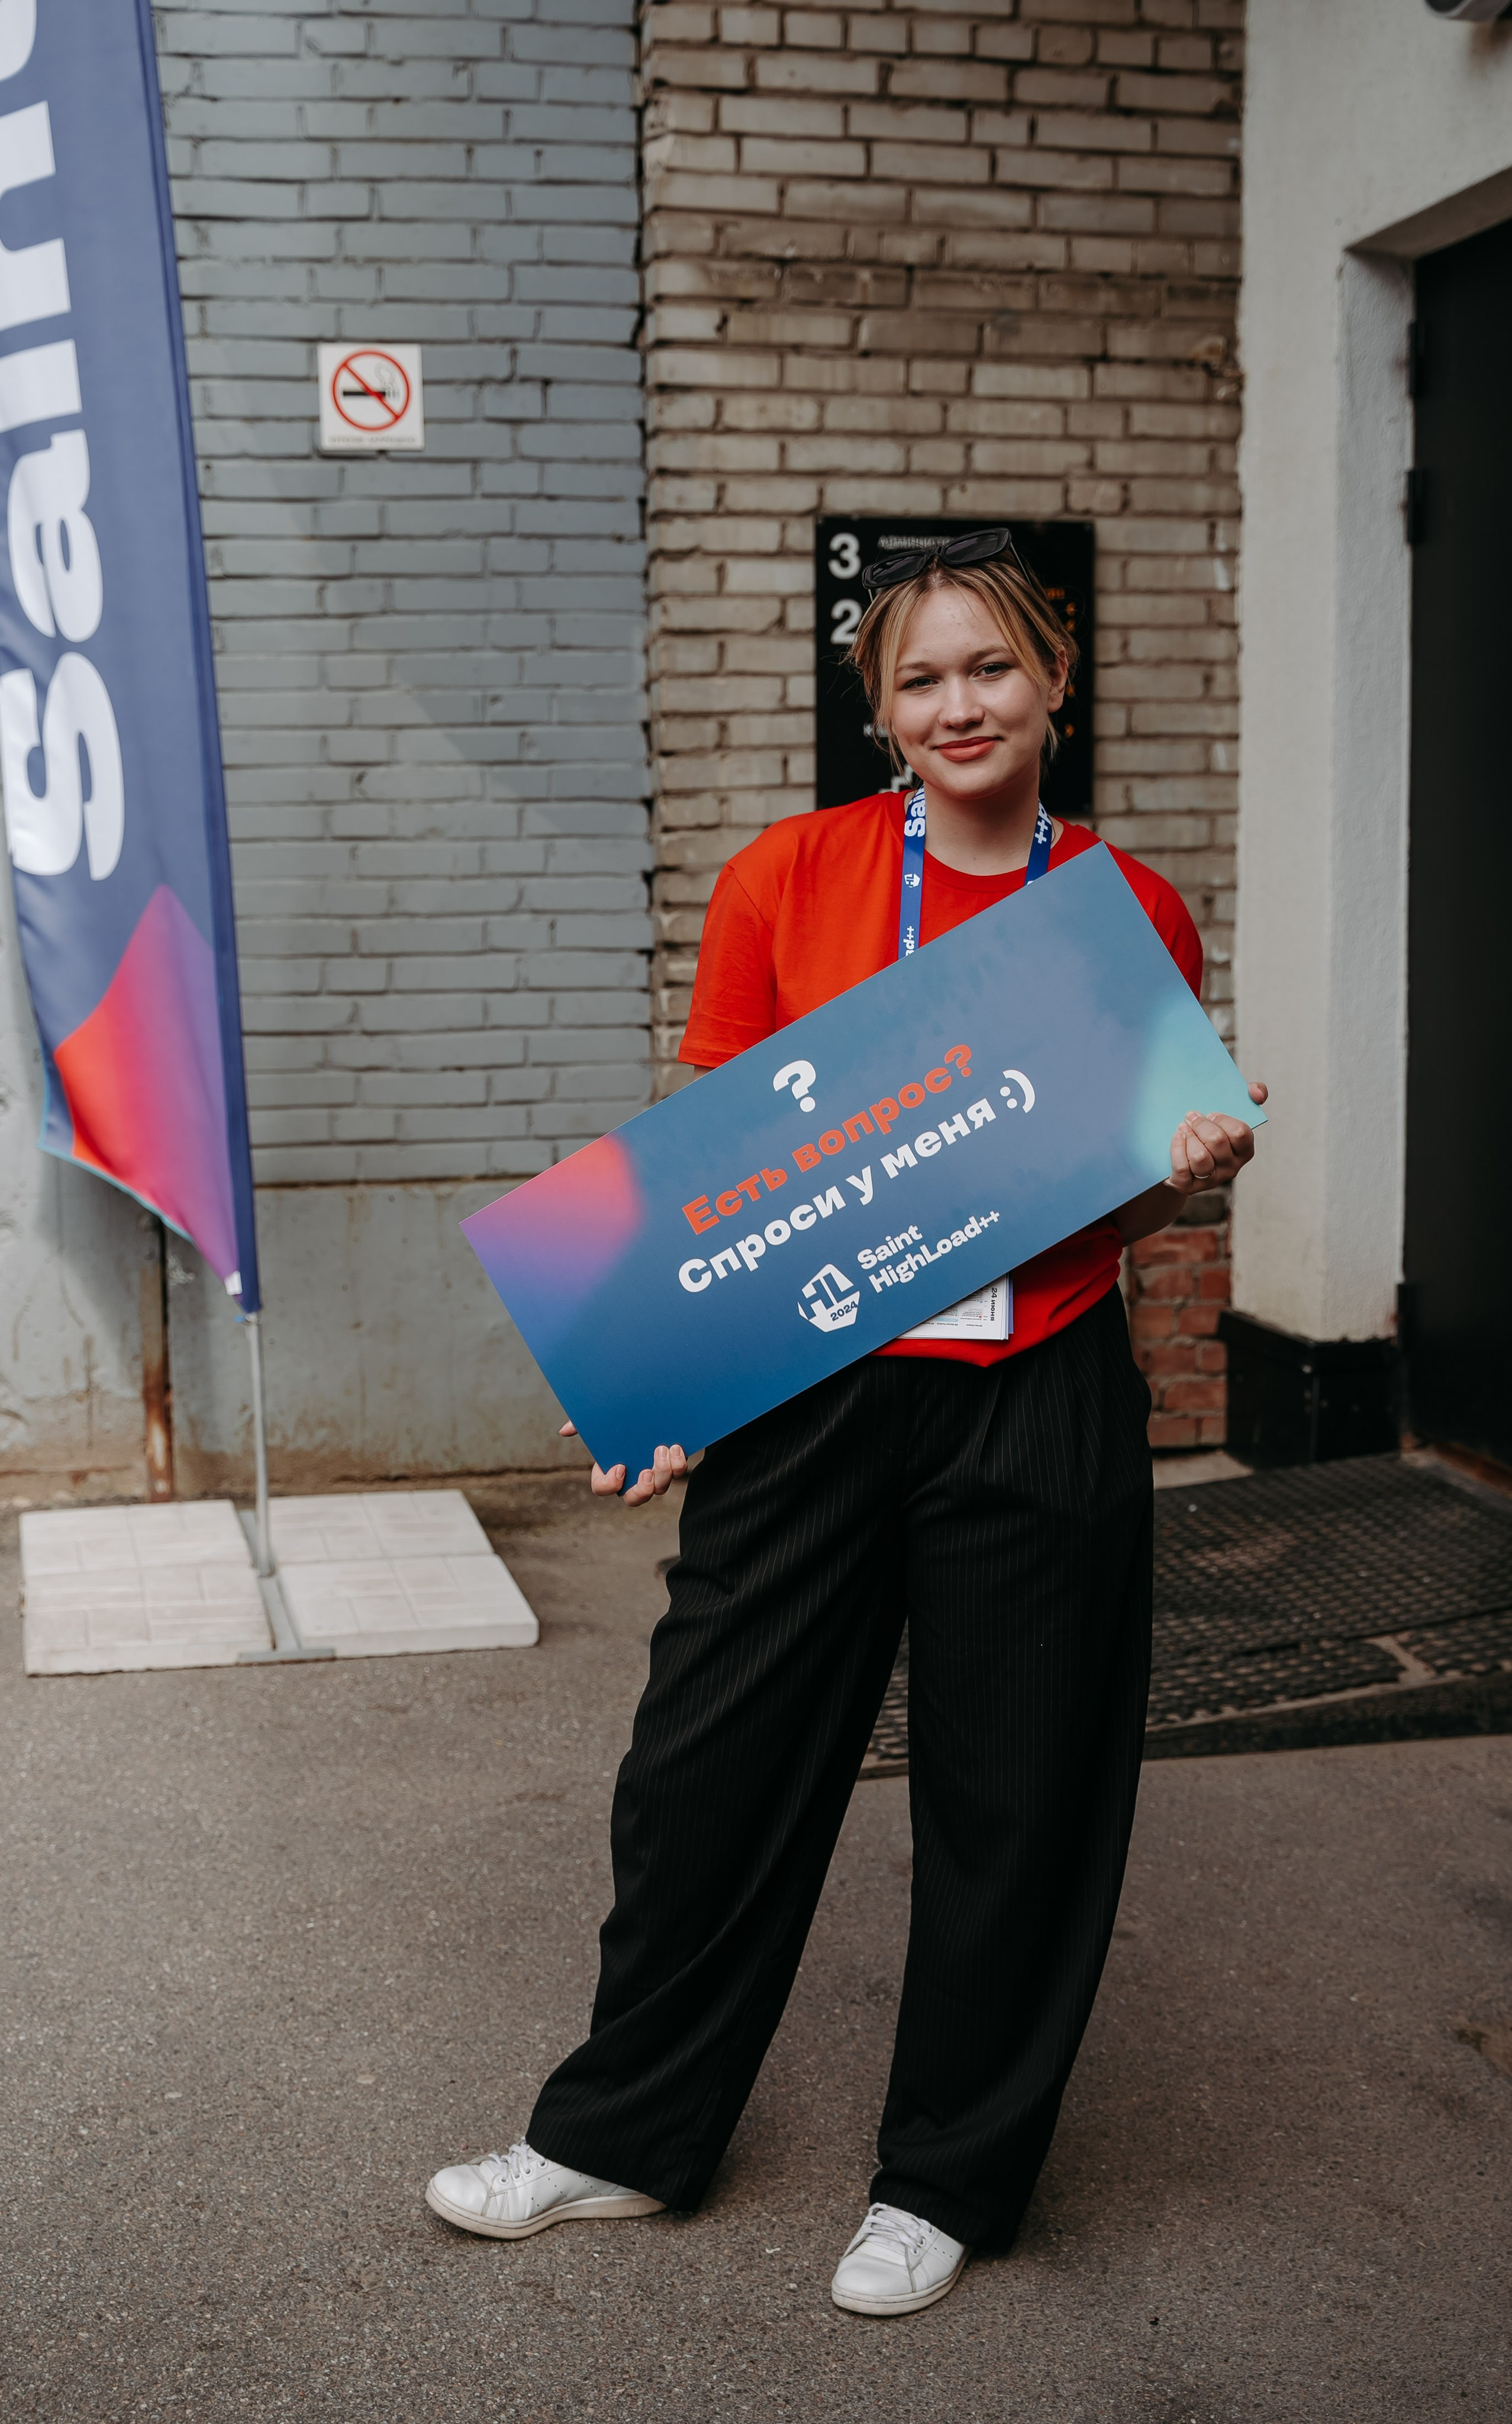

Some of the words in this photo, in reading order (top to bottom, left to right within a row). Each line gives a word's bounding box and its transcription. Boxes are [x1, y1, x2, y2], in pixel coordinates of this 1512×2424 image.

[0, 0, 125, 881] Sain
[828, 533, 861, 579] 3
[830, 598, 863, 644] 2
[682, 1168, 788, 1235] Есть
[791, 1044, 972, 1172] вопрос?
[678, 1185, 847, 1293] Спроси
[845, 1165, 874, 1205] у
[879, 1098, 997, 1179] меня
[857, 1225, 923, 1269] Saint
[868, 1211, 1000, 1293] HighLoad++
[830, 1300, 858, 1321] 2024
[991, 1287, 998, 1298] 24
